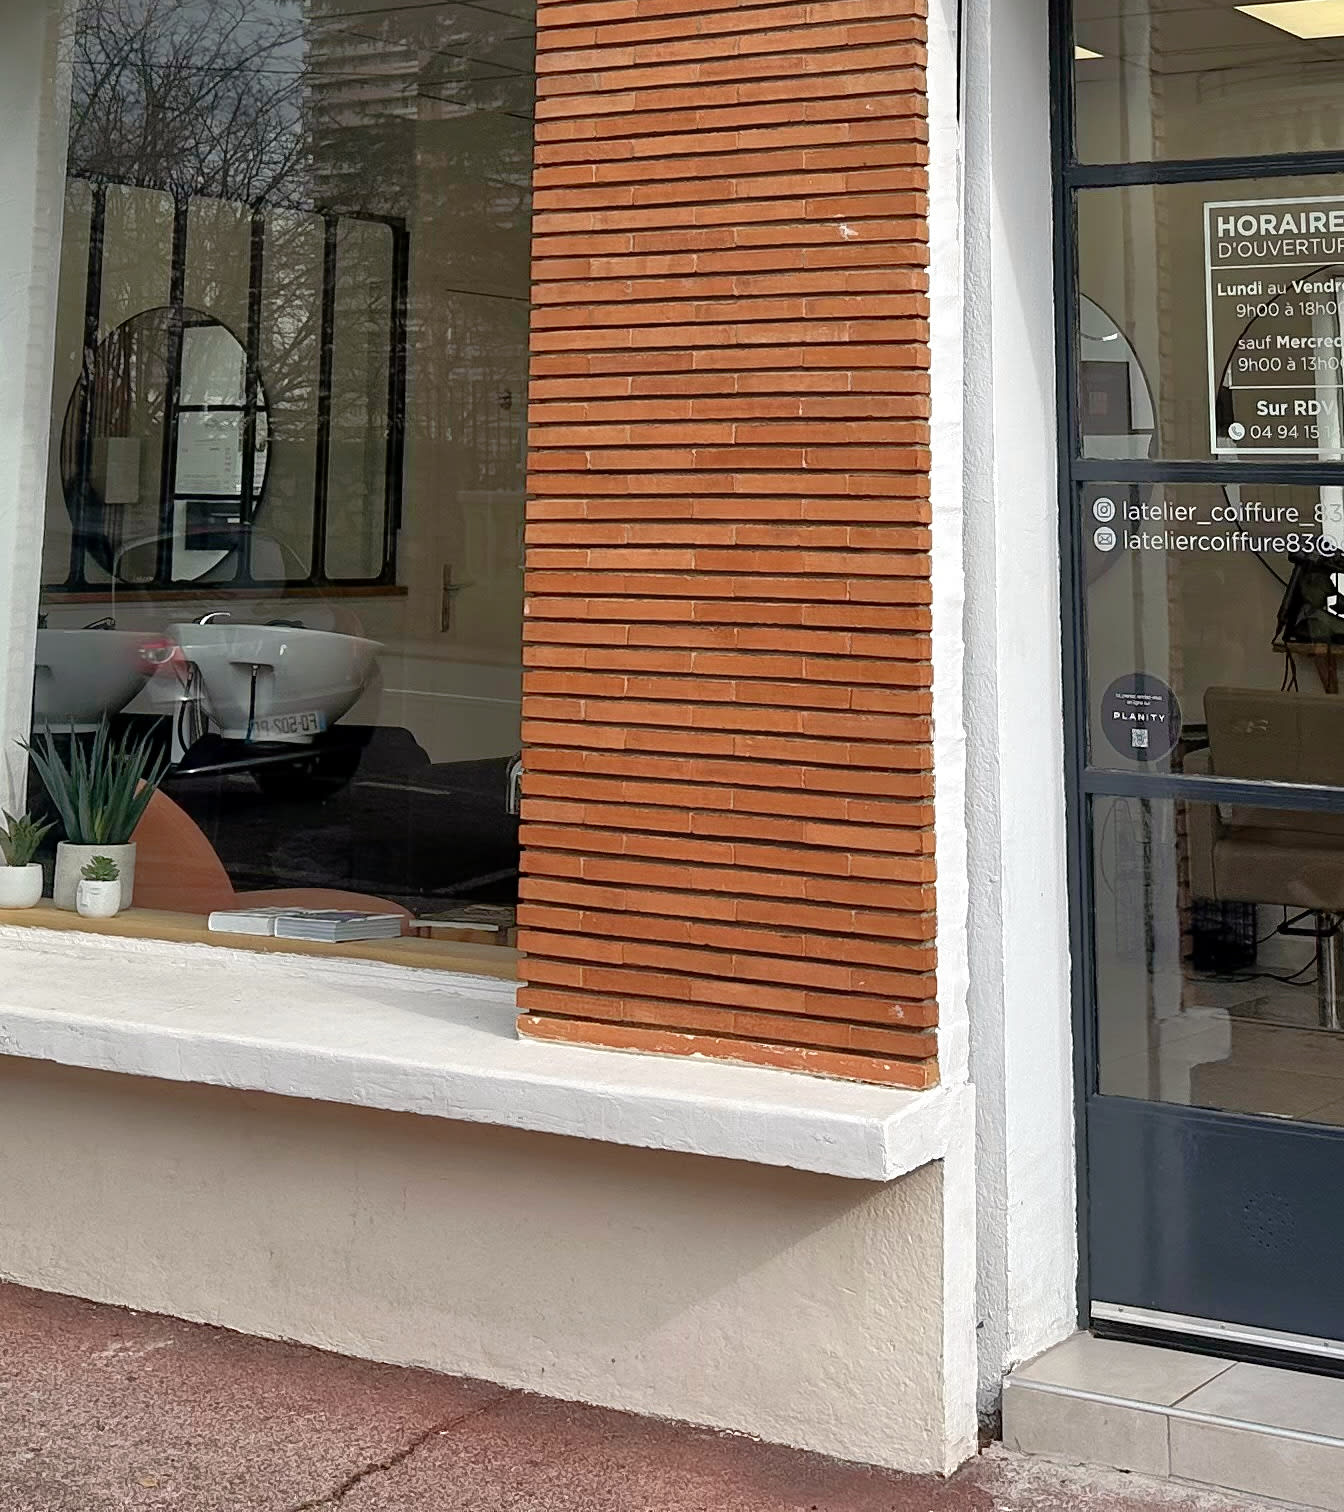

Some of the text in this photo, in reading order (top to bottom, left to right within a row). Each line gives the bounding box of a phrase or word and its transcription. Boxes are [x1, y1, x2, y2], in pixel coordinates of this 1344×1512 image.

[1217, 280, 1263, 296] Lundi
[1267, 283, 1287, 295] au
[1236, 302, 1280, 319] 9h00
[1284, 301, 1294, 317] à
[1238, 335, 1273, 350] sauf
[1238, 356, 1282, 373] 9h00
[1286, 356, 1296, 371] à
[1256, 399, 1337, 417] Sur RDV
[1250, 425, 1273, 440] 04
[1277, 424, 1299, 440] 94
[1303, 424, 1320, 440] 15
[1122, 499, 1343, 529] latelier_coiffure_83
[1113, 711, 1165, 723] PLANITY
